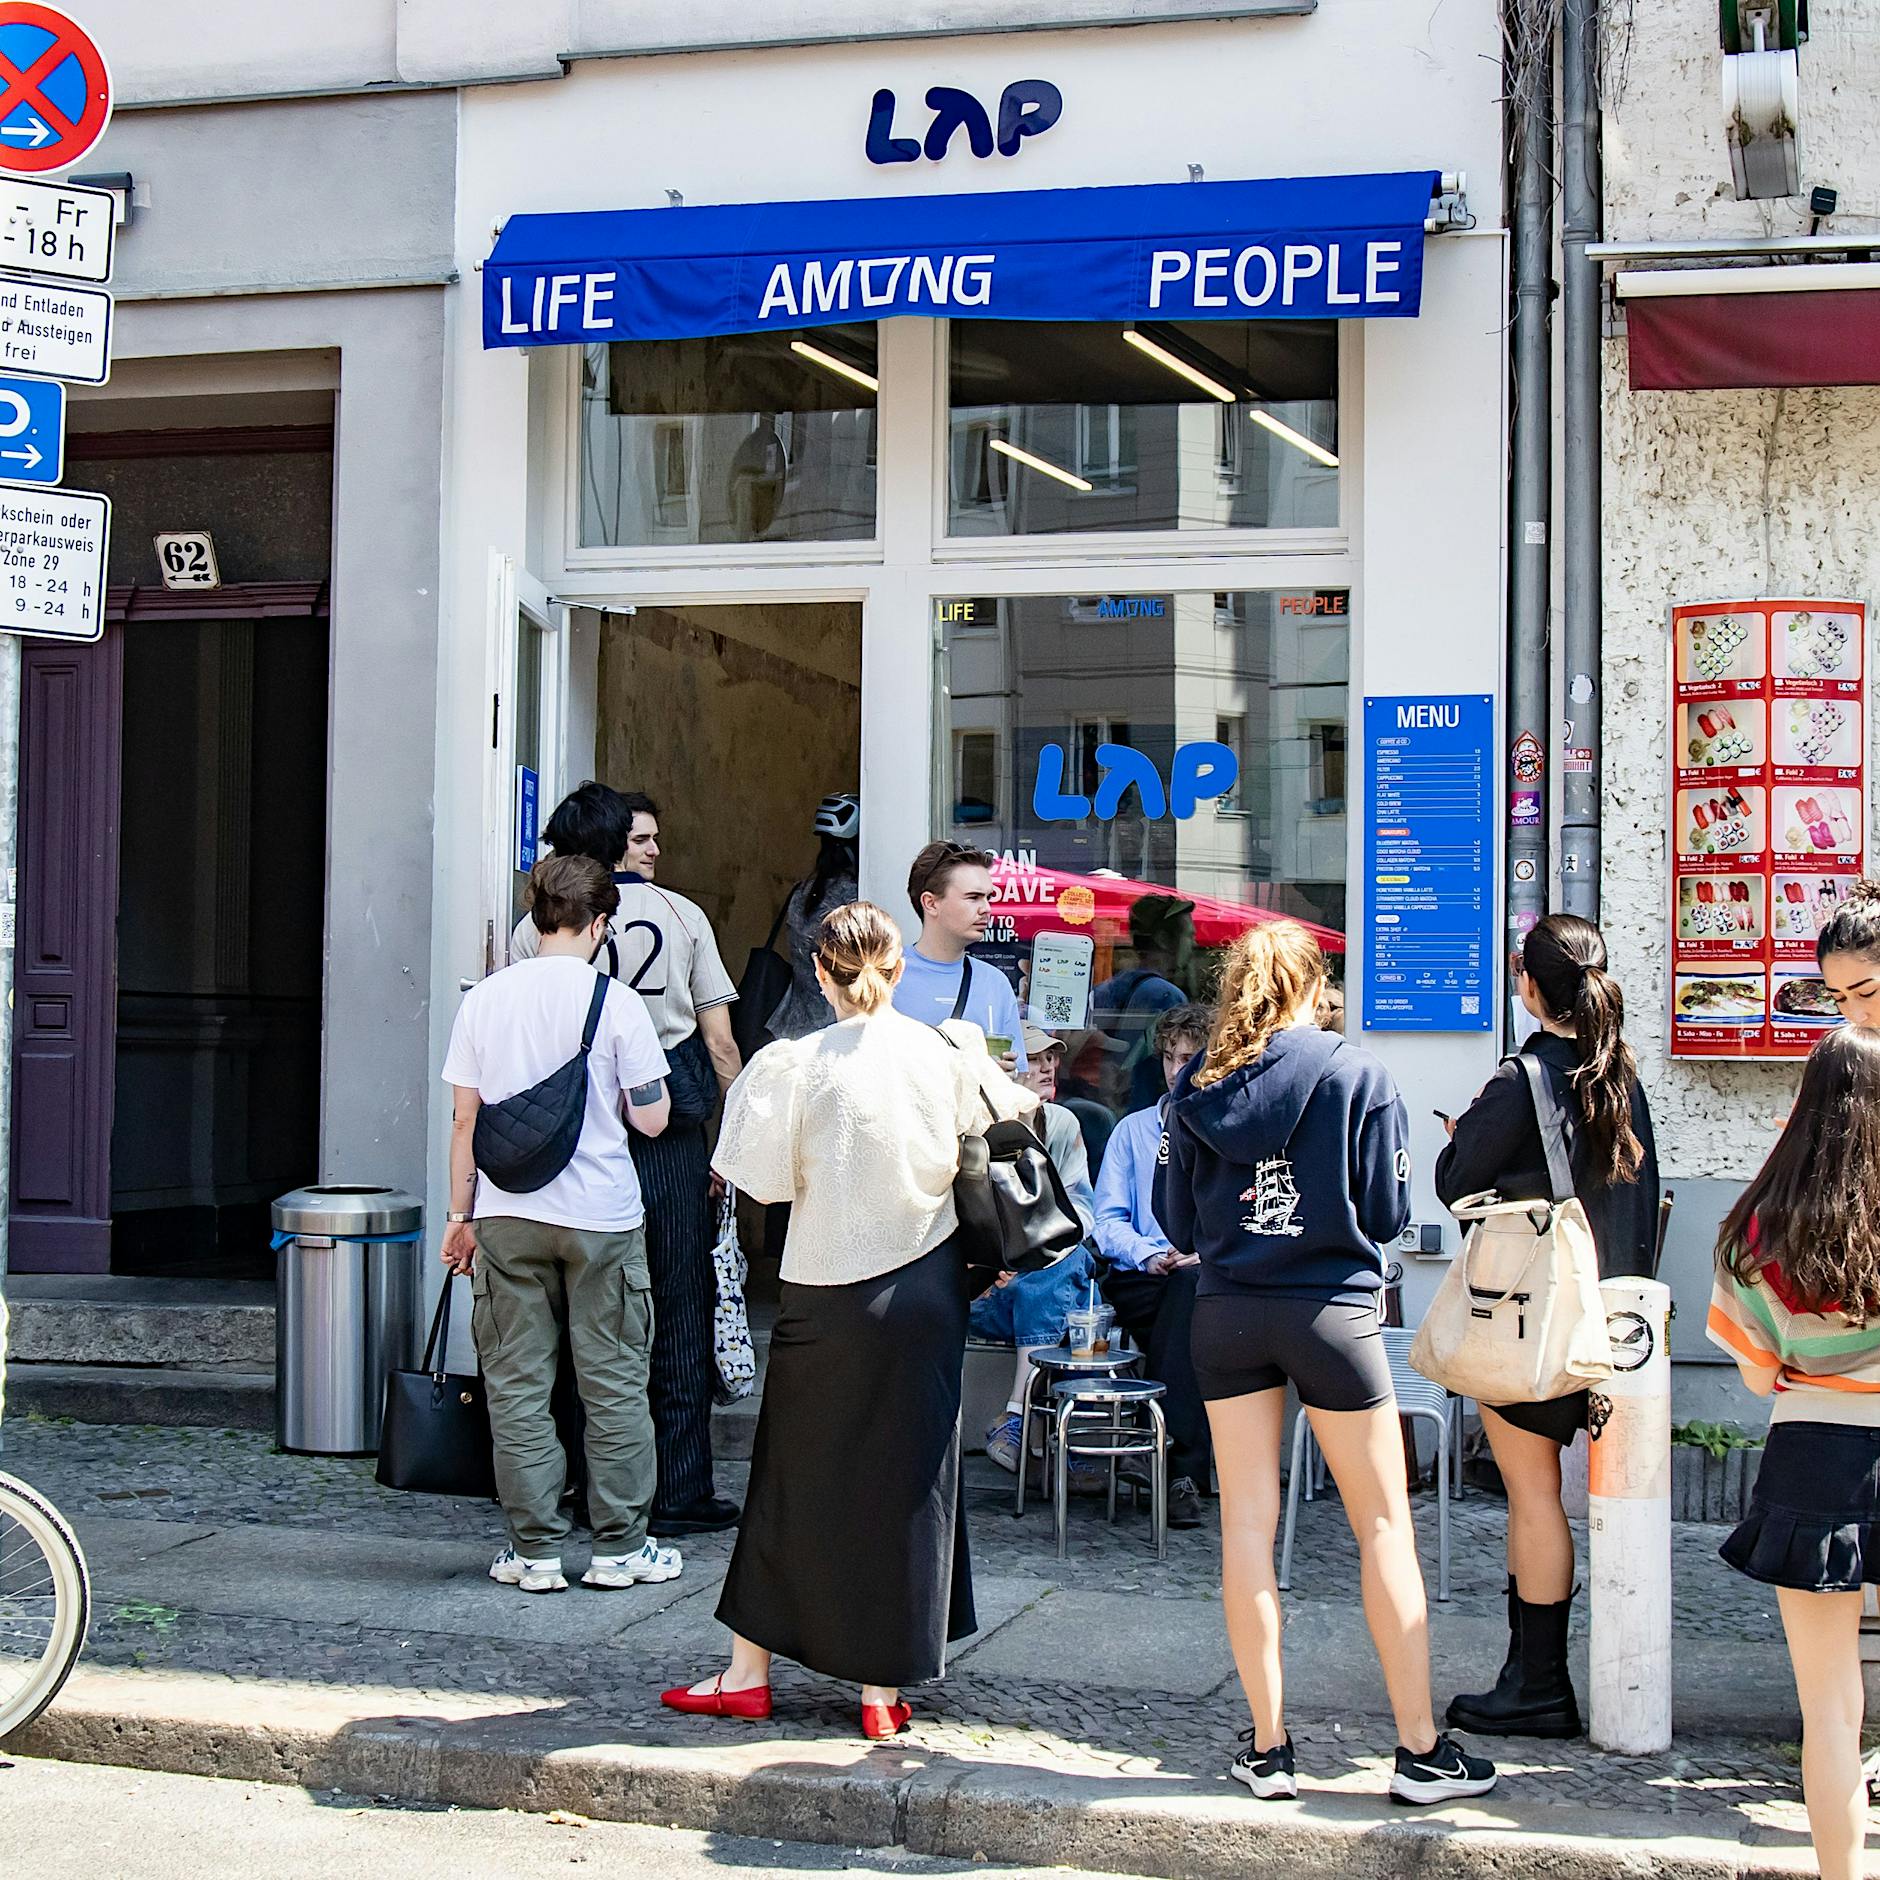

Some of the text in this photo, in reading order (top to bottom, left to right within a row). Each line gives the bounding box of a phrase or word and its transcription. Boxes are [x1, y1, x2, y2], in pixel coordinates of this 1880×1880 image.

[866, 79, 1063, 164] LAP
[57, 199, 88, 227] Fr
[68, 234, 84, 261] h
[499, 242, 1403, 334] LIFE AMONG PEOPLE
[25, 295, 84, 318] Entladen
[17, 319, 92, 345] Aussteigen
[5, 342, 36, 361] frei
[61, 513, 92, 530] oder
[3, 550, 59, 571] Zone 29
[164, 541, 208, 573] 62
[10, 575, 26, 589] 18
[83, 582, 91, 597] h
[15, 598, 26, 612] 9
[82, 604, 90, 619] h
[938, 603, 974, 622] LIFE
[1280, 596, 1344, 616] PEOPLE
[1397, 704, 1460, 728] MENU
[1034, 742, 1239, 821] LAP
[997, 915, 1015, 929] TO
[997, 929, 1019, 942] UP:
